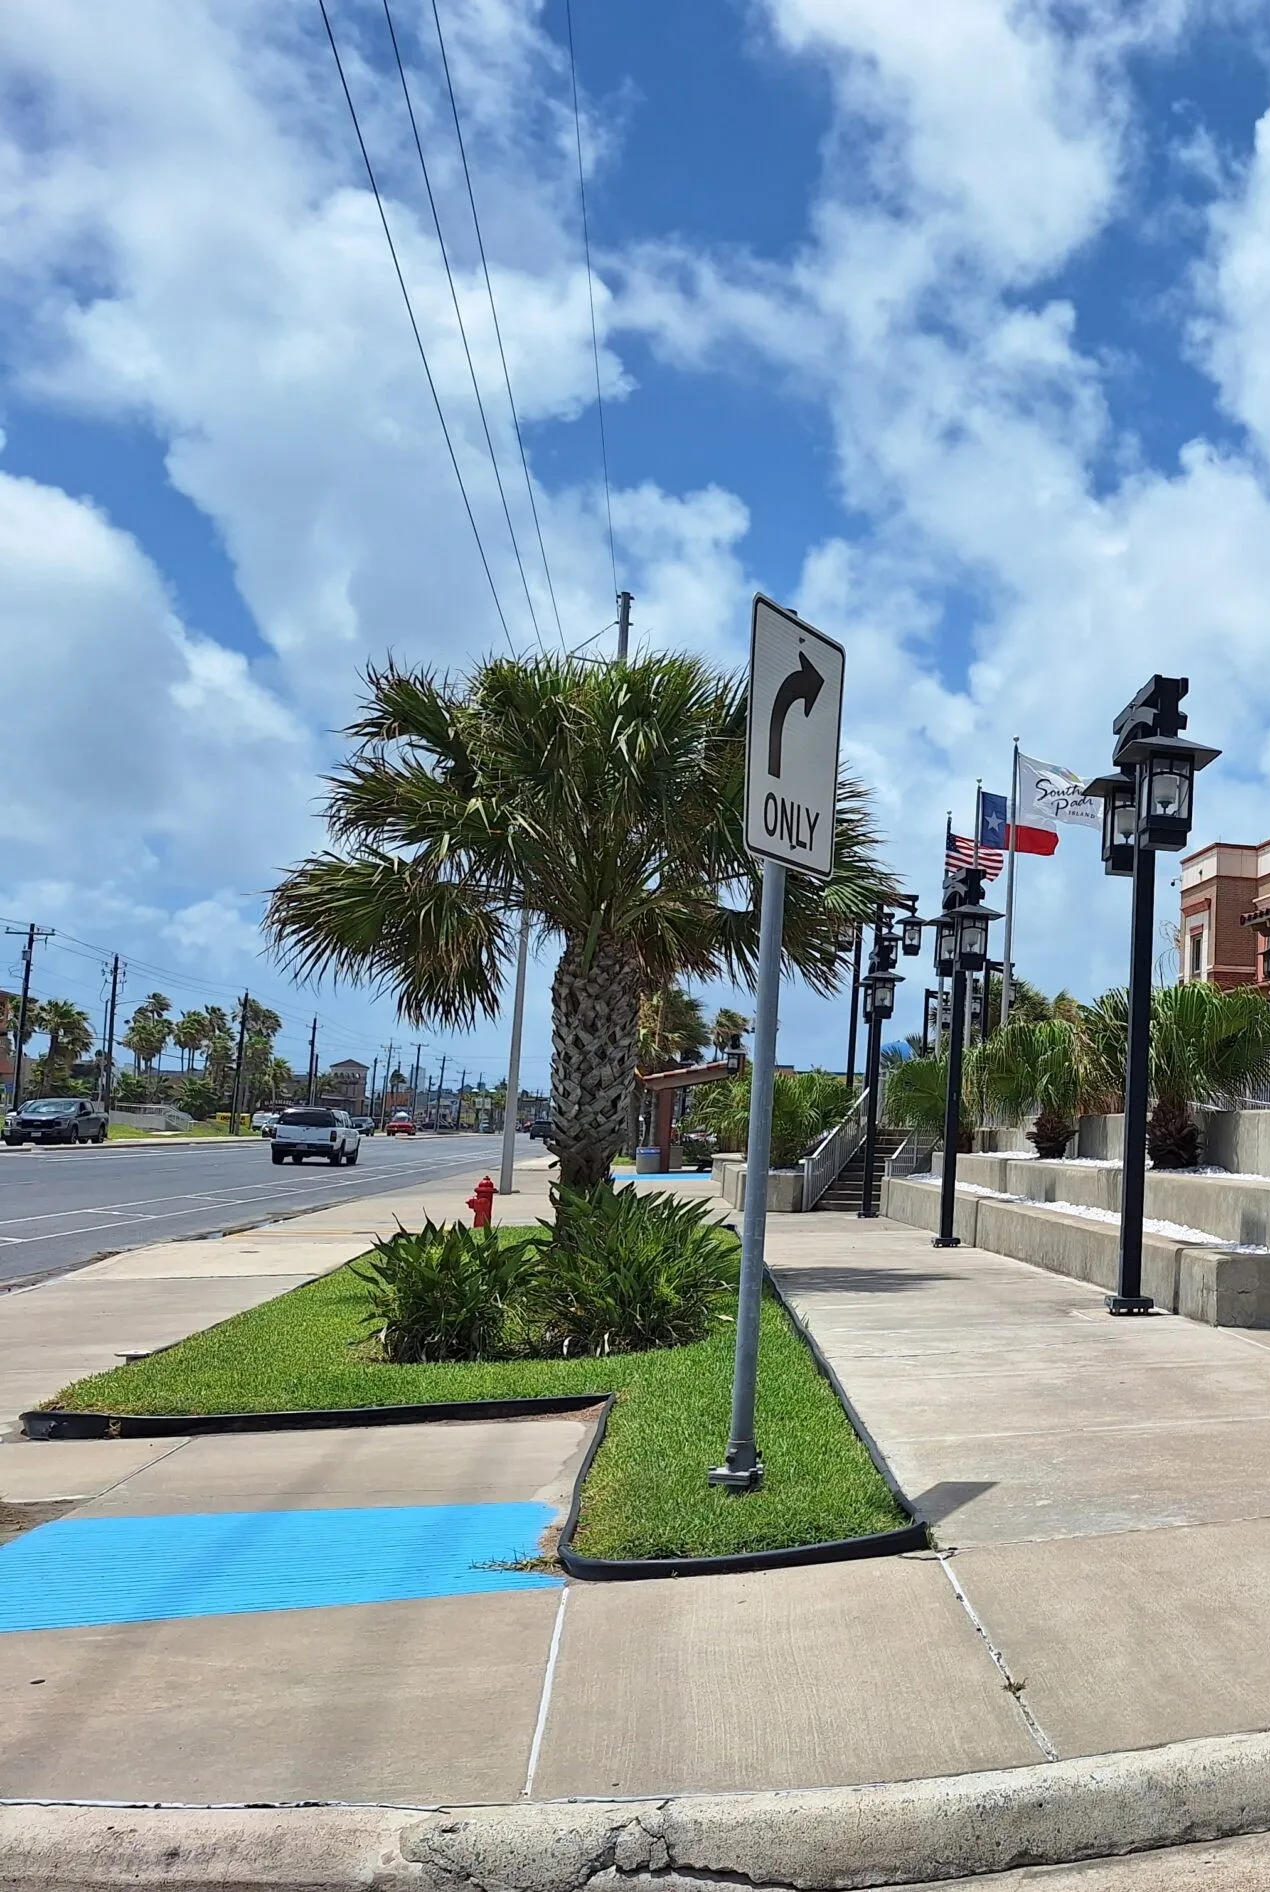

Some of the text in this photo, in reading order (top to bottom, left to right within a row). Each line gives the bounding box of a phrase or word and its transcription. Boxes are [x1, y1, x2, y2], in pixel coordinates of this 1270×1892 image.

[1036, 779, 1083, 801] South
[764, 792, 820, 851] ONLY
[1068, 810, 1096, 819] ISLAND
